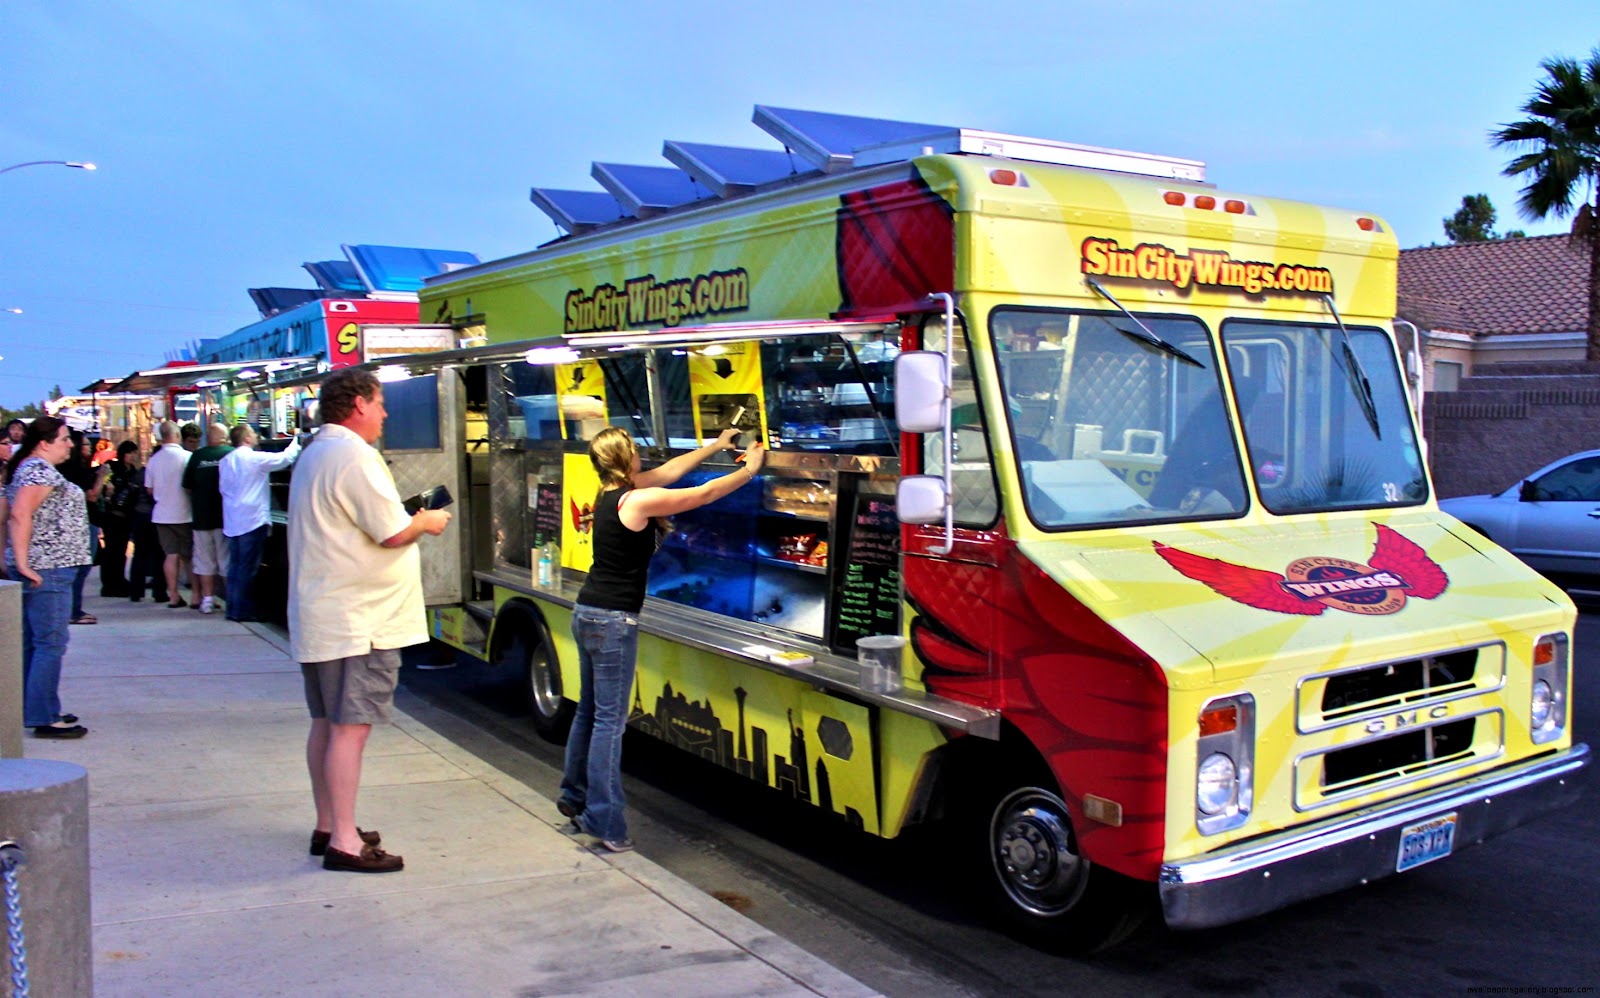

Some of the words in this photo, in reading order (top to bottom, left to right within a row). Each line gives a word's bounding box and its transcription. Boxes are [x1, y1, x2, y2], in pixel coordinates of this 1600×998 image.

[1081, 237, 1333, 294] SinCityWings.com
[565, 267, 749, 332] SinCityWings.com
[1382, 482, 1399, 502] 32
[1290, 557, 1315, 576] SIN
[1312, 557, 1360, 571] CITY
[1286, 572, 1401, 597] WINGS
[1363, 597, 1402, 613] things
